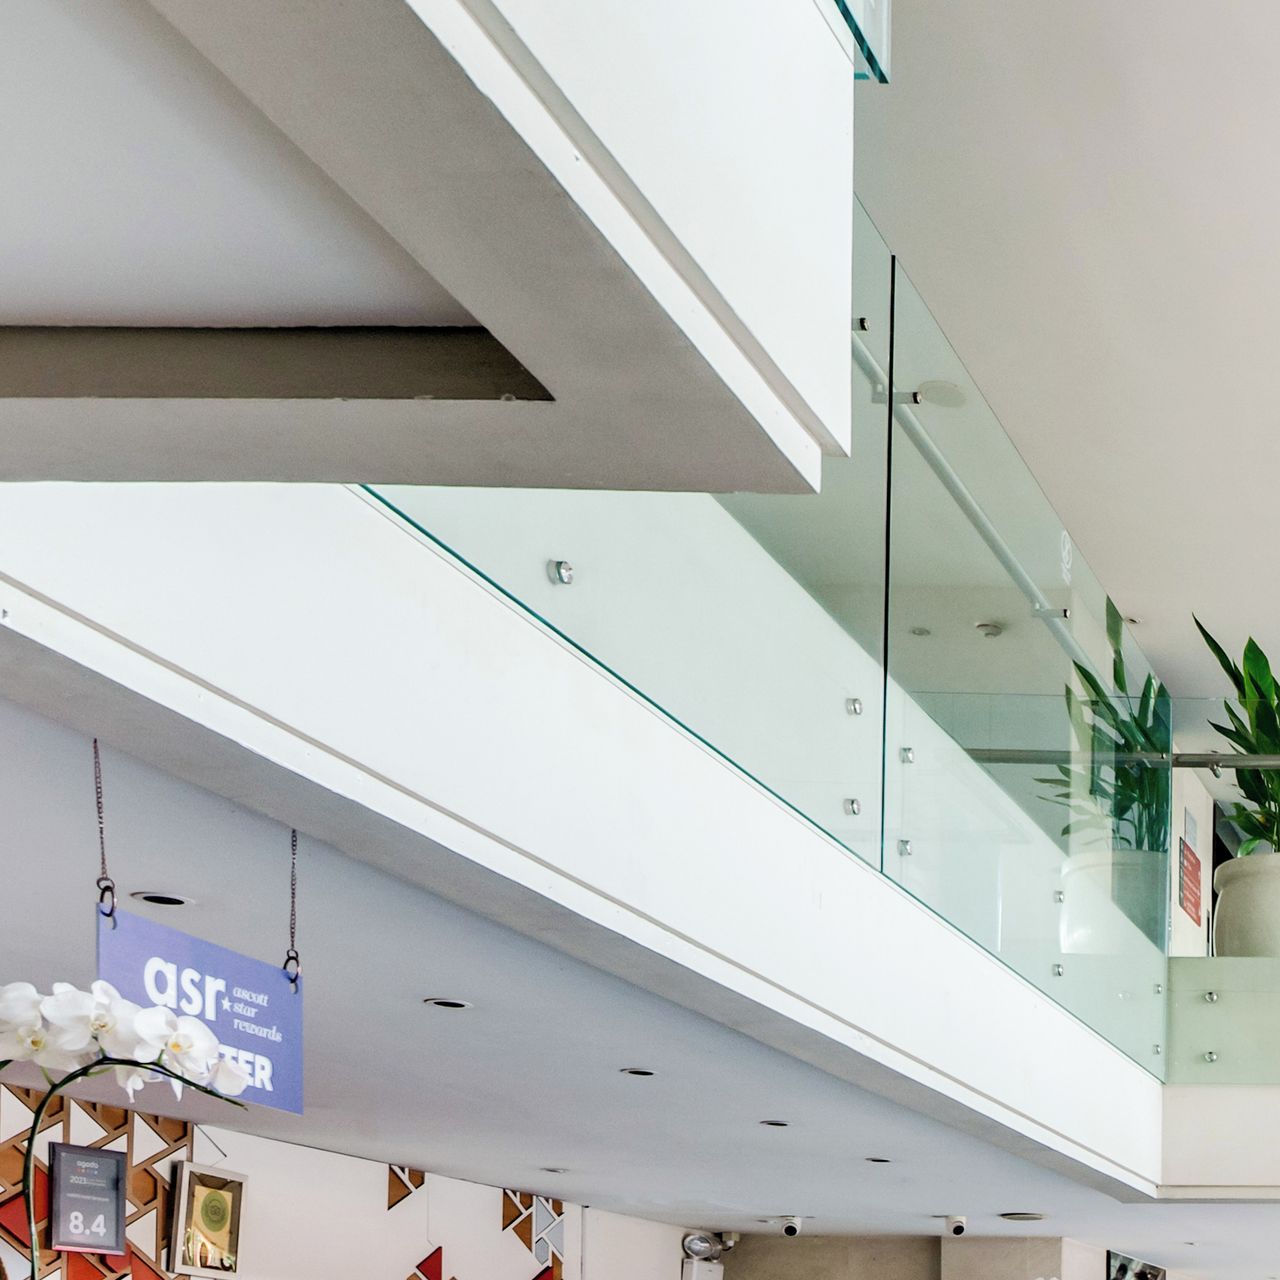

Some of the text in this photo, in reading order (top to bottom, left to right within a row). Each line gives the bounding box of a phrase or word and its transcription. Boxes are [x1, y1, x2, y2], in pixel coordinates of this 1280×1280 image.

[144, 957, 226, 1021] asr
[232, 986, 269, 1007] ascott
[232, 1001, 258, 1018] star
[233, 1018, 283, 1042] rewards
[69, 1210, 107, 1237] 8.4
